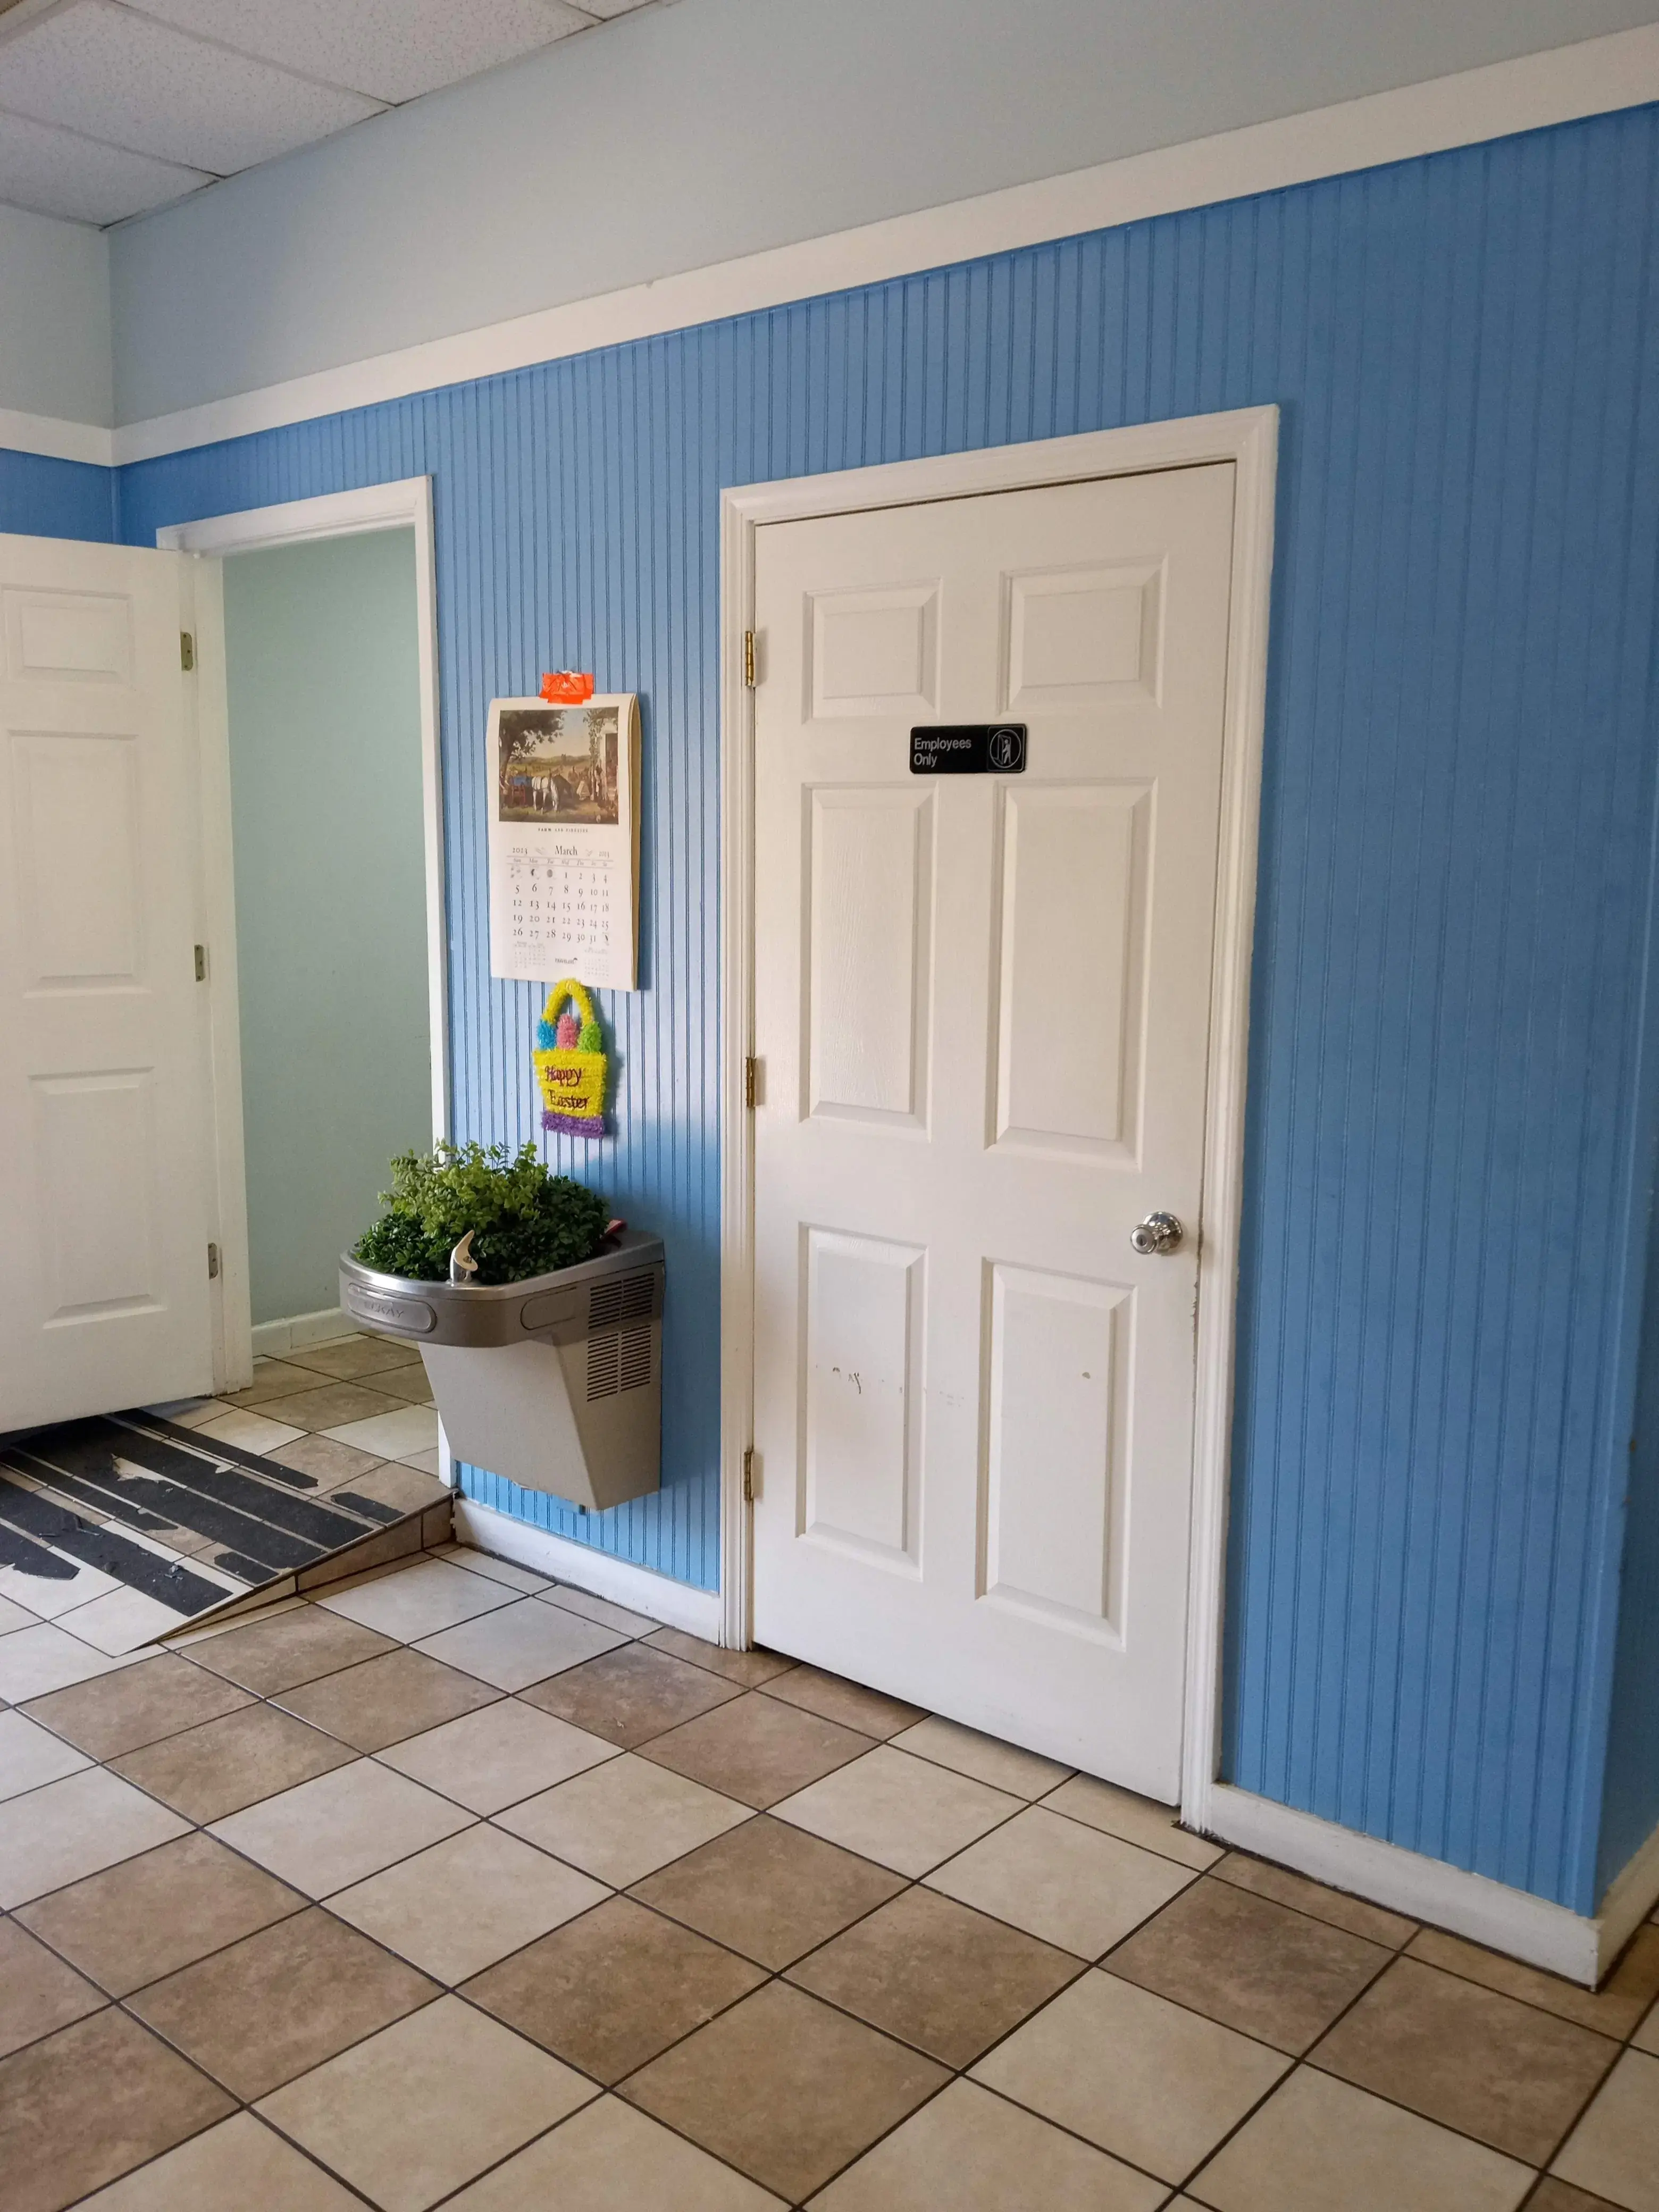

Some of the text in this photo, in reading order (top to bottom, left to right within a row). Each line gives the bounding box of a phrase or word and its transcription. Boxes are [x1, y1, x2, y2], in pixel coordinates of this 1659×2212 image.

[914, 737, 972, 752] Employees
[914, 752, 937, 768] Only
[555, 845, 577, 856] March
[592, 874, 595, 883] 3
[604, 875, 607, 884] 4
[515, 885, 520, 894] 5
[532, 883, 537, 892] 6
[549, 886, 553, 895] 7
[564, 885, 568, 893] 8
[579, 888, 583, 898] 9
[530, 900, 540, 910] 13
[547, 901, 557, 911] 14
[563, 902, 570, 912] 15
[577, 901, 586, 910] 16
[591, 904, 597, 913] 17
[602, 903, 609, 912] 18
[514, 915, 523, 924] 19
[577, 919, 584, 928] 23
[590, 919, 597, 929] 24
[602, 921, 608, 931] 25
[513, 927, 596, 944] 26 27 28 29 30 31
[544, 1065, 582, 1087] Happy
[548, 1089, 590, 1109] Easter
